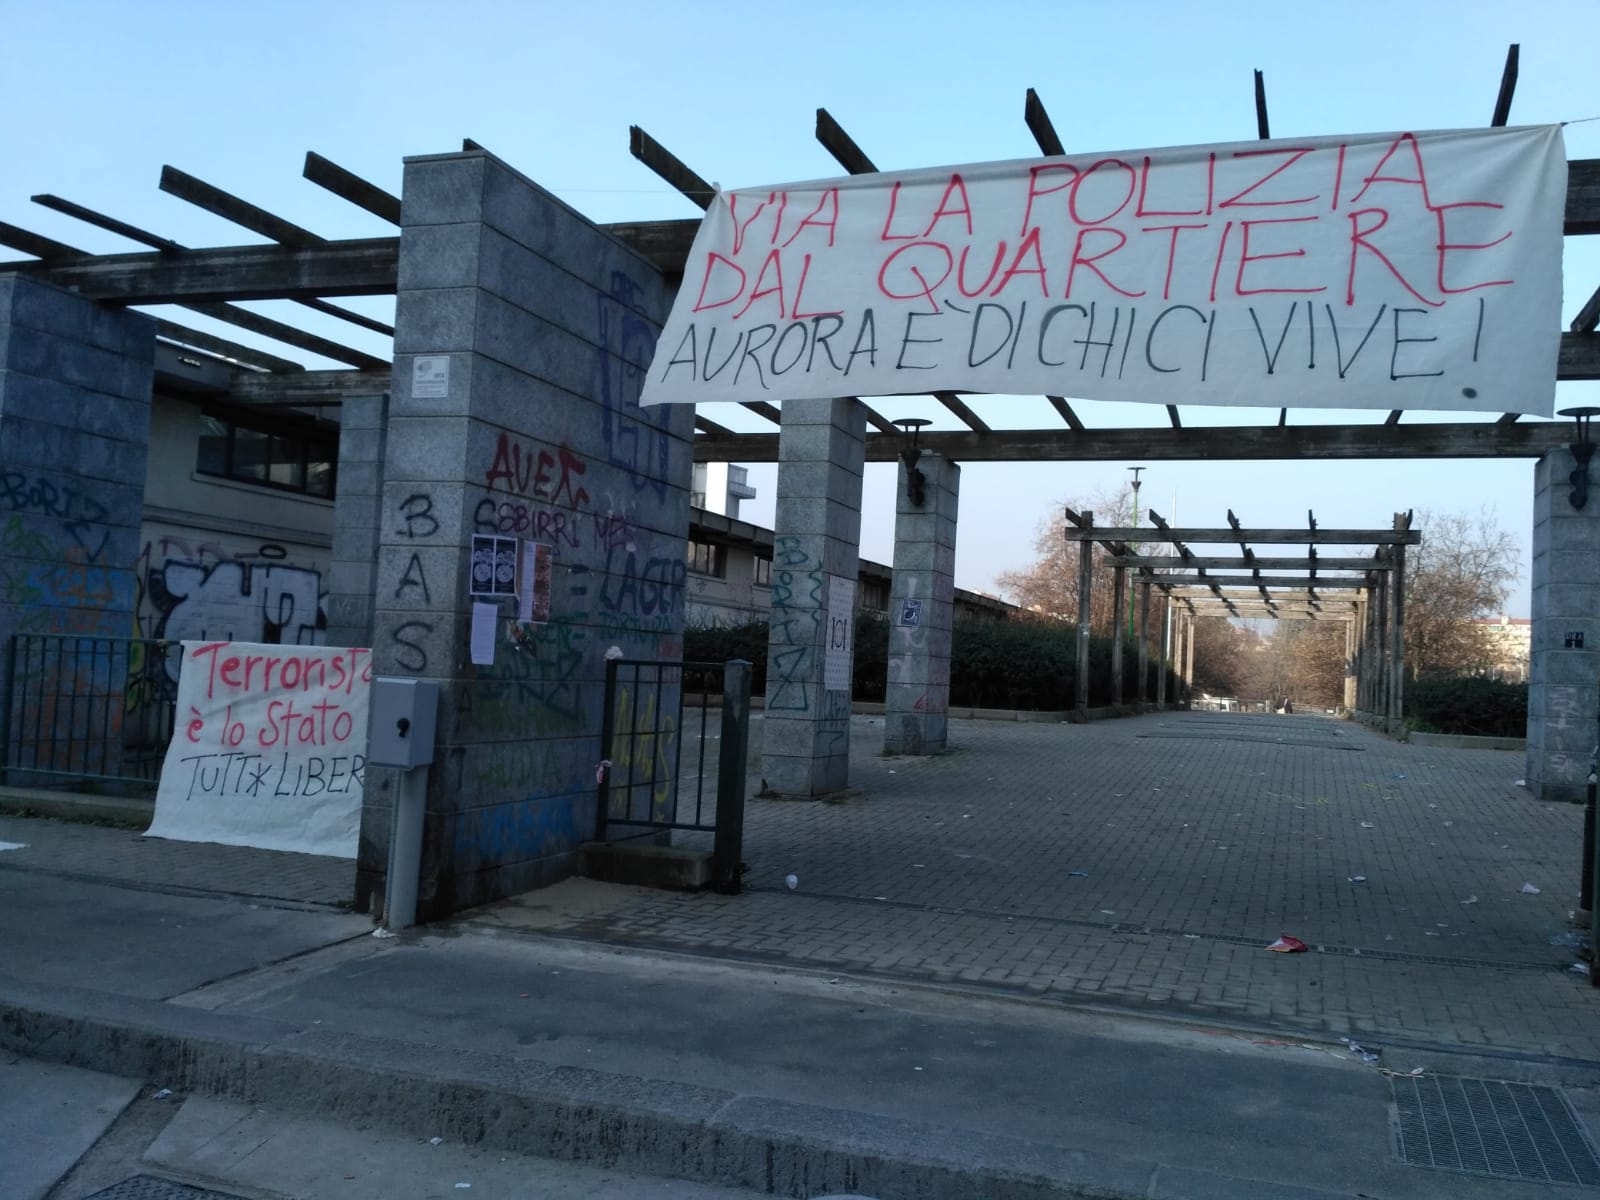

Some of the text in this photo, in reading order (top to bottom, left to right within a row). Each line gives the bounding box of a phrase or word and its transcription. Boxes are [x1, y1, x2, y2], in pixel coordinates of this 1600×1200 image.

[730, 132, 1432, 255] VIA LA POLIZIA
[691, 202, 1515, 319] DAL QUARTIERE
[661, 307, 879, 390] AURORA
[967, 300, 1026, 370] DI
[1037, 300, 1136, 381] CHI
[1145, 304, 1216, 382] CI
[497, 501, 580, 548] SBIRRI
[186, 698, 353, 747] è lo Stato
